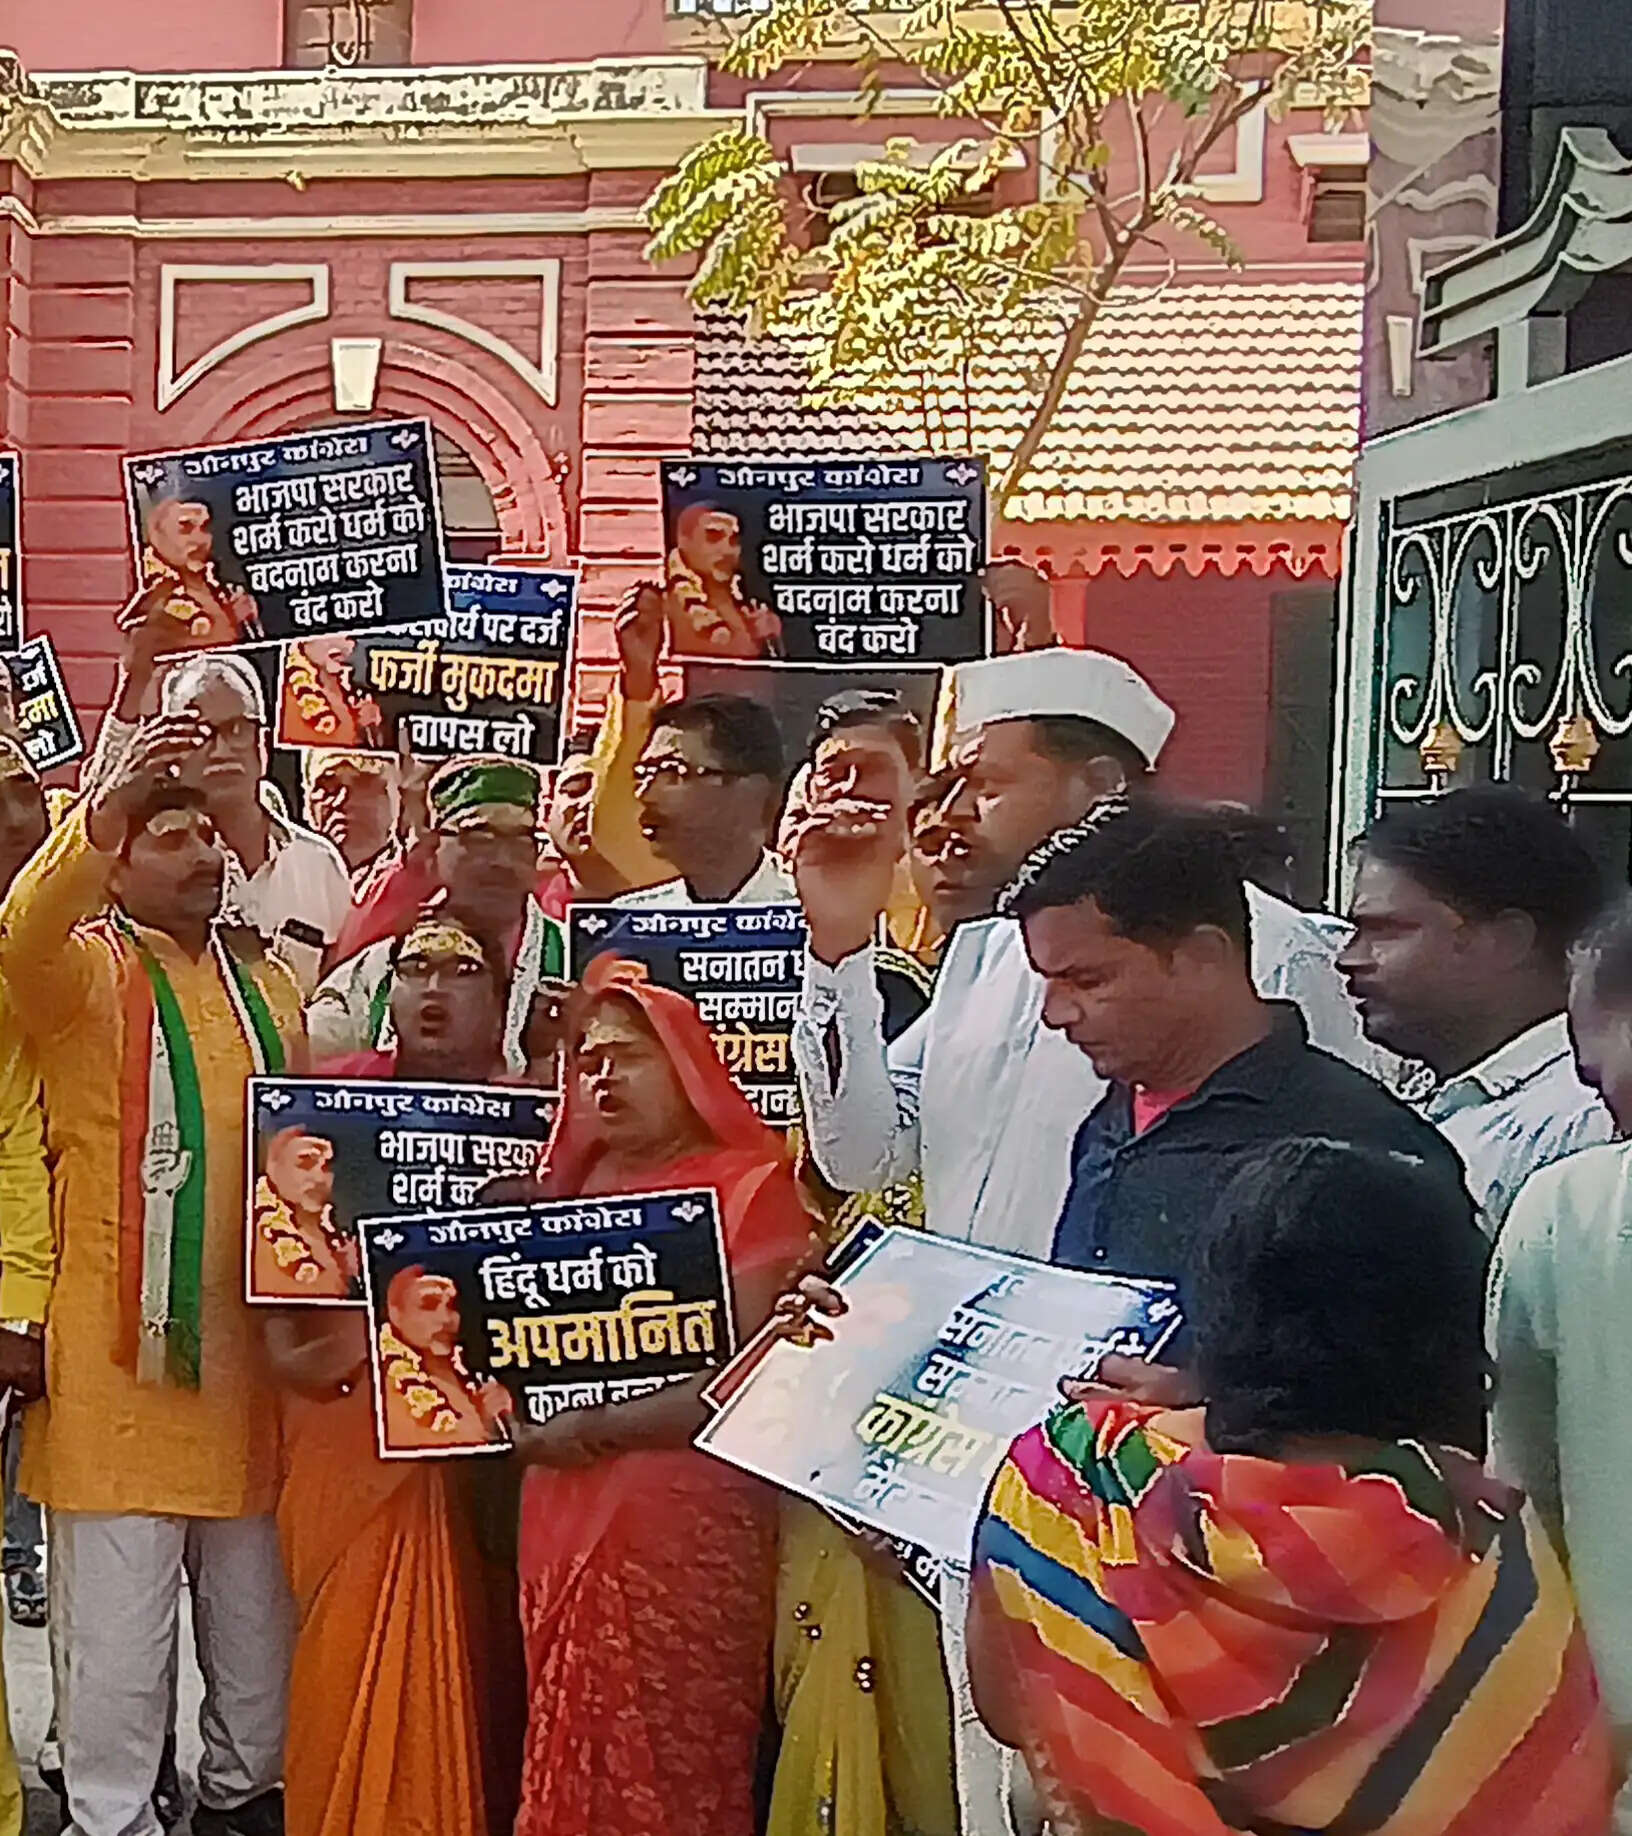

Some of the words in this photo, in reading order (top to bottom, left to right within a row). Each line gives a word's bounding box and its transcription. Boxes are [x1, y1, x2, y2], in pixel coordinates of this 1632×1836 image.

[236, 475, 318, 513] भाजपा
[319, 463, 414, 505] सरकार
[232, 512, 282, 555] शर्म
[285, 503, 336, 548] करो
[340, 496, 389, 542] धर्म
[391, 494, 426, 534] को
[769, 503, 859, 533] भाजपा
[861, 500, 967, 532] सरकार
[342, 544, 418, 578] करना
[762, 536, 816, 573] शर्म
[818, 535, 875, 574] करो
[878, 534, 930, 573] धर्म
[934, 534, 976, 573] को
[332, 581, 384, 619] करो
[876, 584, 962, 615] करना
[481, 614, 518, 644] पर
[519, 609, 562, 646] दर्ज
[860, 617, 918, 653] करो
[370, 639, 439, 695] फर्जी
[441, 654, 559, 711] मुकदमा
[409, 714, 489, 751] वापस
[490, 713, 535, 755] लो
[680, 951, 789, 982] सनातन
[422, 1093, 511, 1118] कांग्रेस
[379, 1130, 466, 1164] भाजपा
[392, 1165, 446, 1205] शर्म
[480, 1252, 551, 1308] हिंदू
[543, 1244, 604, 1294] धर्म
[606, 1243, 658, 1288] को
[488, 1290, 717, 1369] अपमानित
